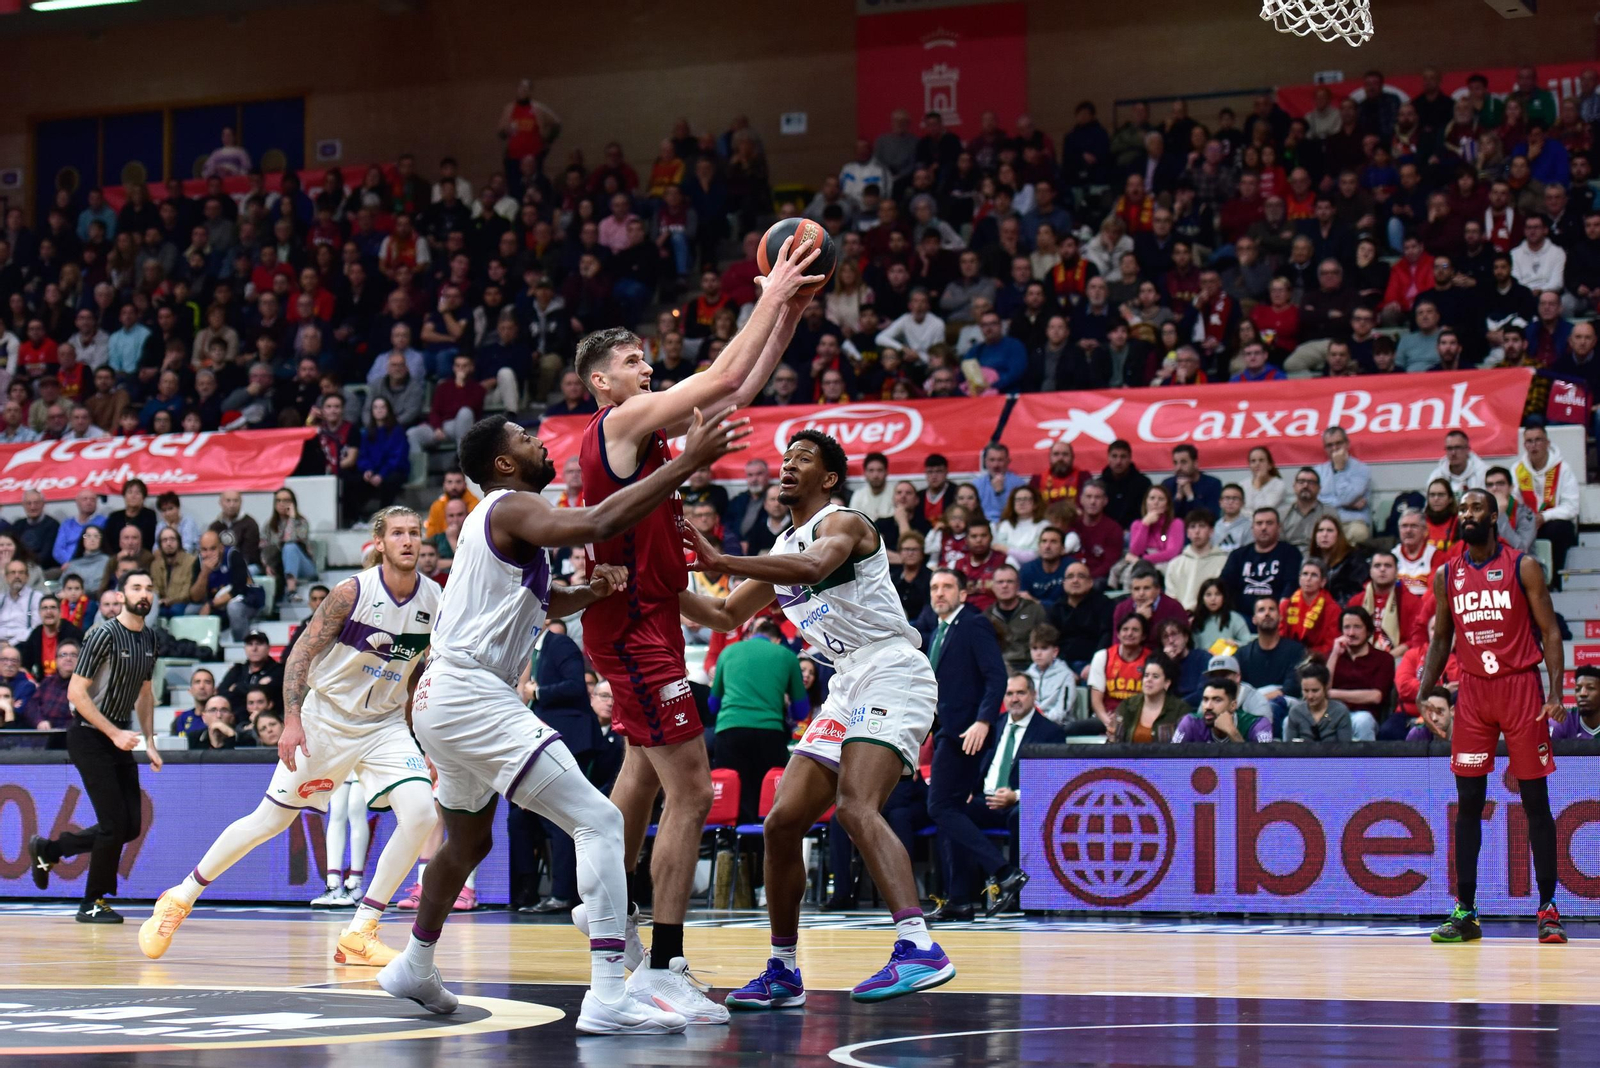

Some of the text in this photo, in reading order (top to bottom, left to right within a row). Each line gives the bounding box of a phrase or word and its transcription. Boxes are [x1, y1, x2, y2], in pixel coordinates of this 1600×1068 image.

[1137, 382, 1486, 443] CaixaBank
[1453, 590, 1512, 614] UCAM
[1462, 610, 1504, 624] MURCIA
[823, 632, 845, 654] 6
[1481, 650, 1500, 675] 8
